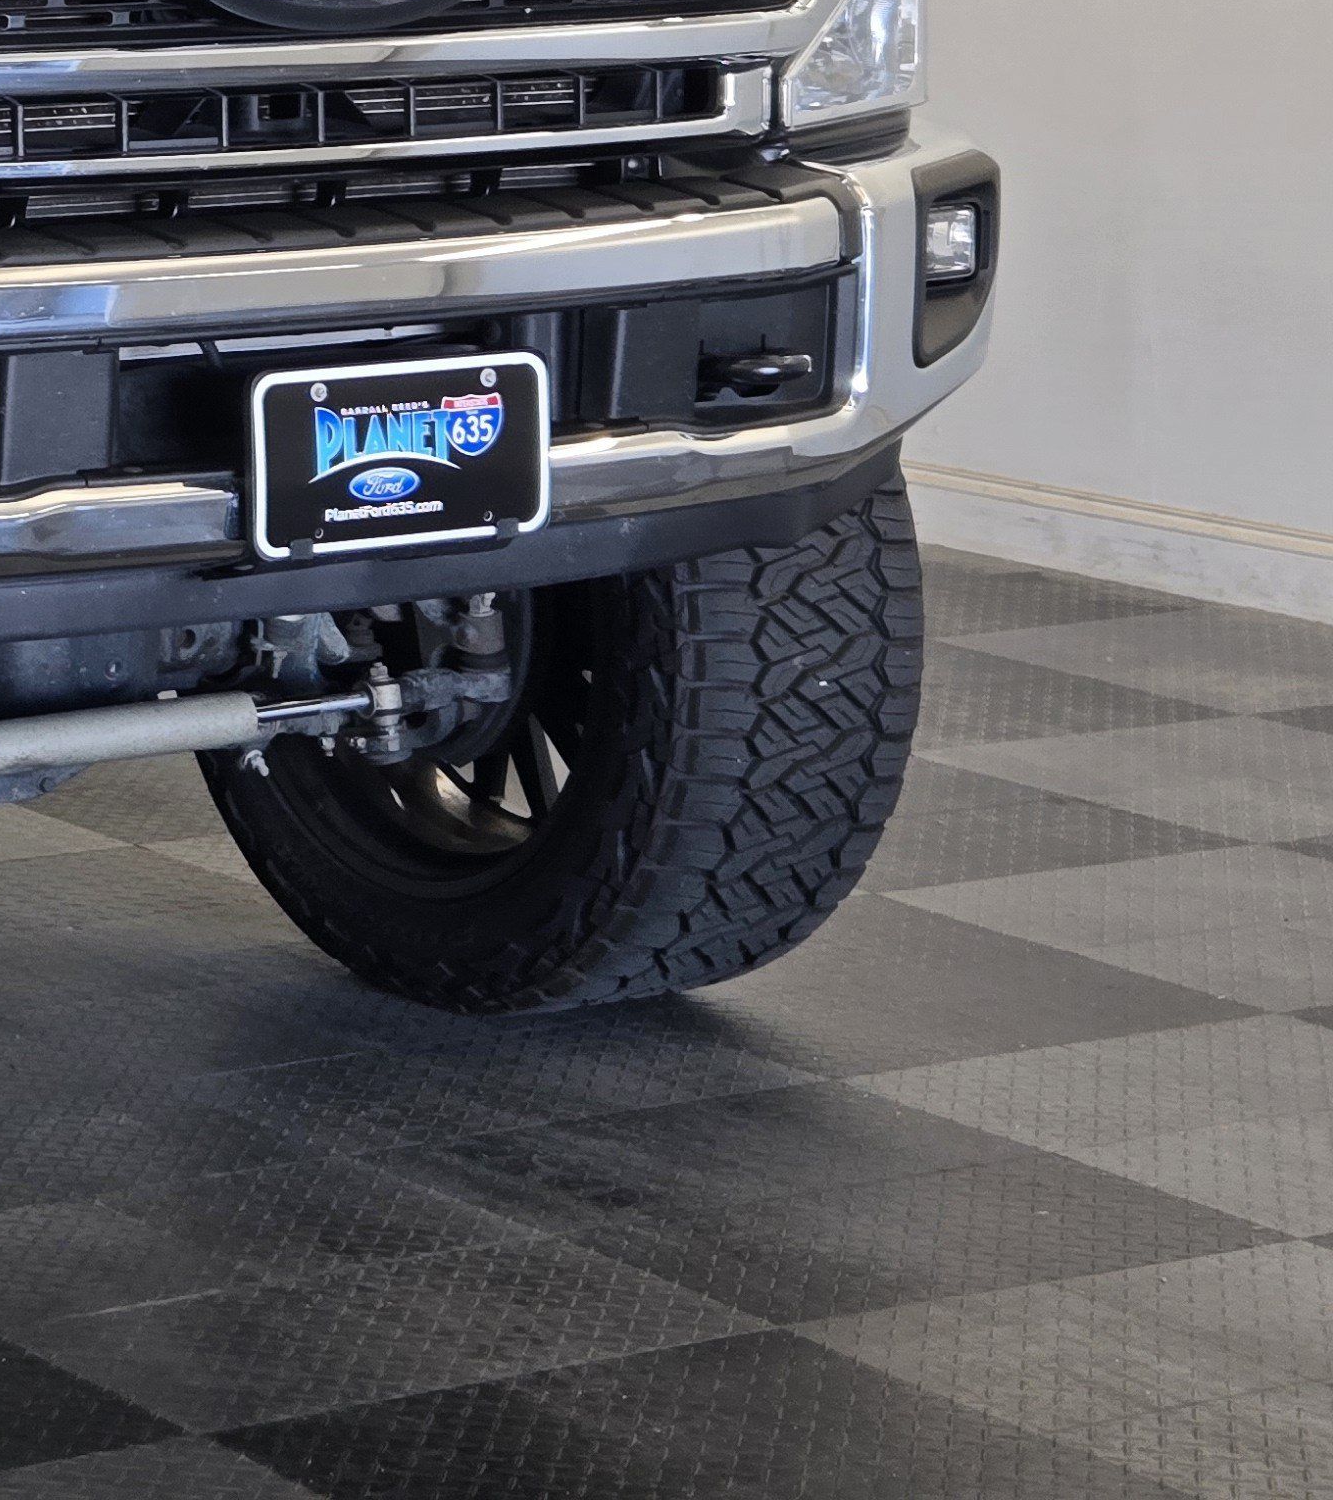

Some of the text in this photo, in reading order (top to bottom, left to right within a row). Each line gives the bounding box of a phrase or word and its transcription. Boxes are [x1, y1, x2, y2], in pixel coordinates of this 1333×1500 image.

[314, 406, 451, 477] PLANET
[452, 414, 494, 445] 635
[362, 473, 406, 497] Ford
